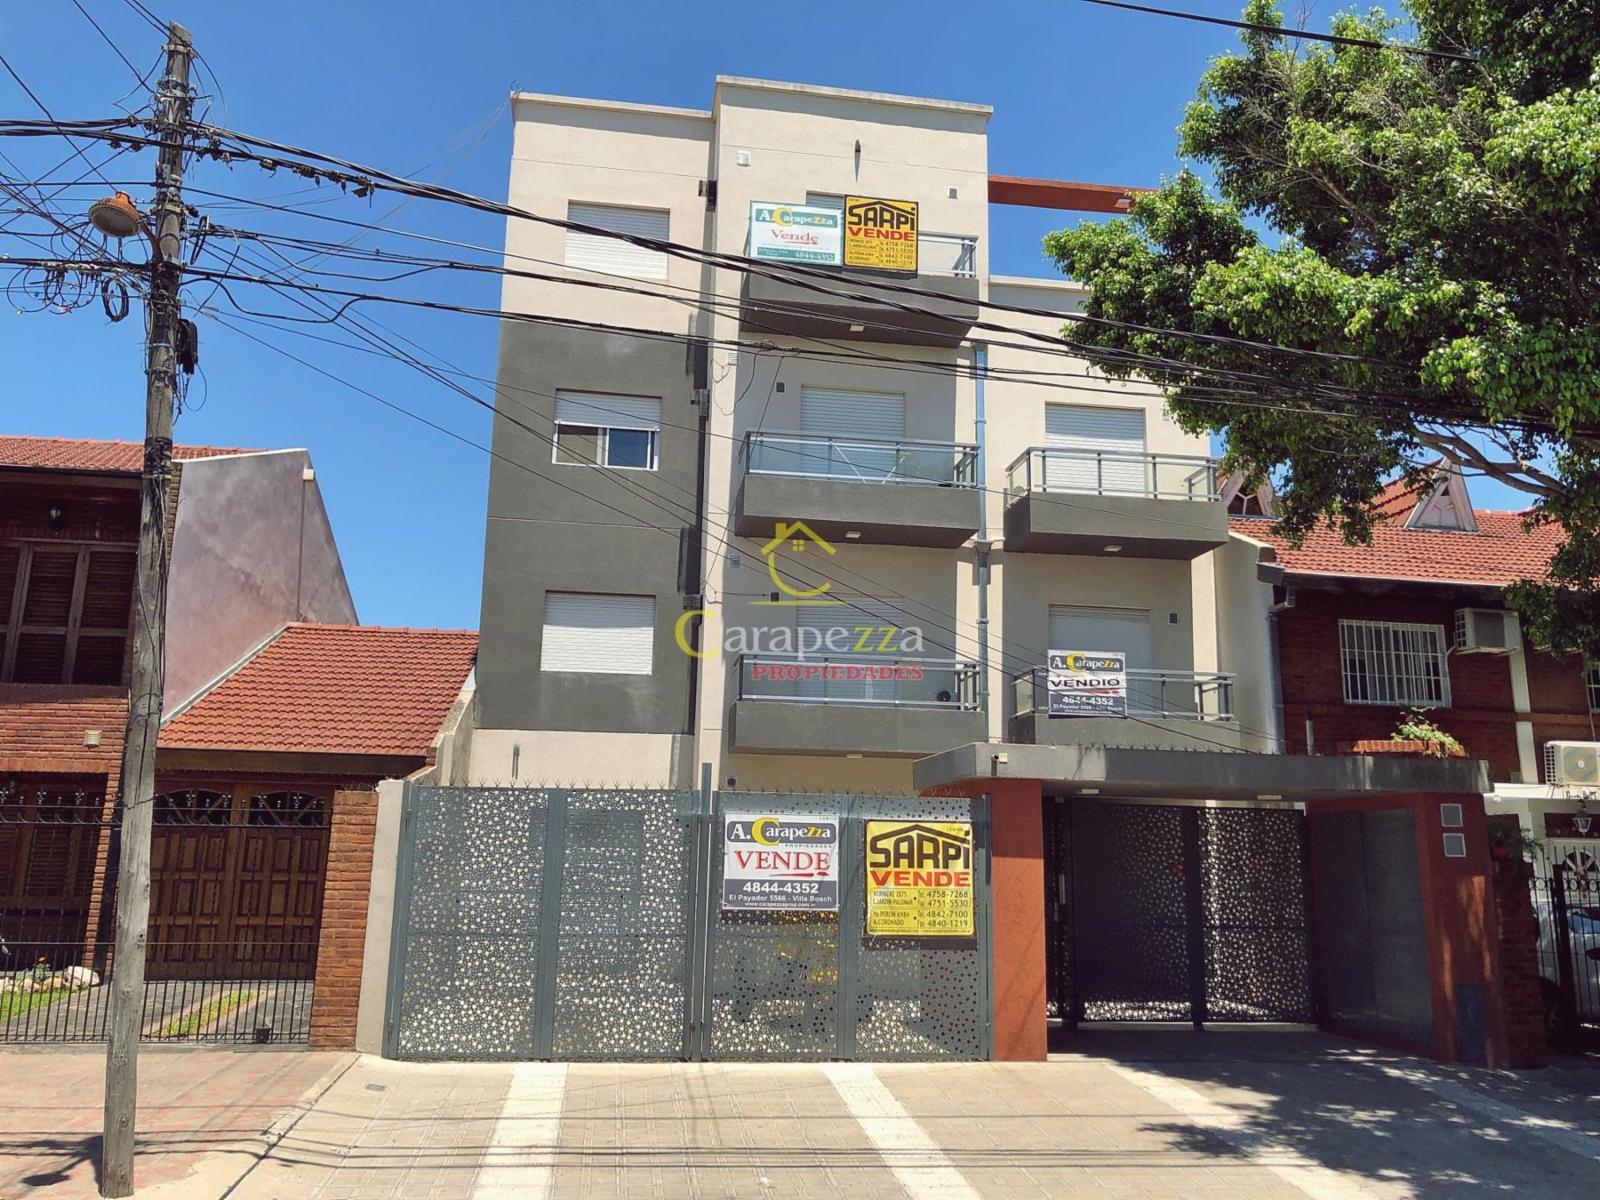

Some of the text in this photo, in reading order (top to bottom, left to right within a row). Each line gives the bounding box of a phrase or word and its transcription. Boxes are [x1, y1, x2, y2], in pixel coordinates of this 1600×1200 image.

[772, 207, 834, 227] Carapezza
[770, 229, 820, 241] Vende
[848, 227, 915, 241] VENDE
[1053, 652, 1120, 672] A. Carapezza
[1049, 678, 1120, 687] VENDIO
[730, 817, 831, 846] A. Carapezza
[734, 850, 831, 870] VENDE
[870, 870, 970, 887] VENDE
[743, 882, 819, 893] 4844-4352
[738, 894, 768, 902] Payador
[926, 890, 968, 898] 4758-7268
[928, 899, 969, 907] 4751-5530
[926, 910, 968, 918] 4842-7100
